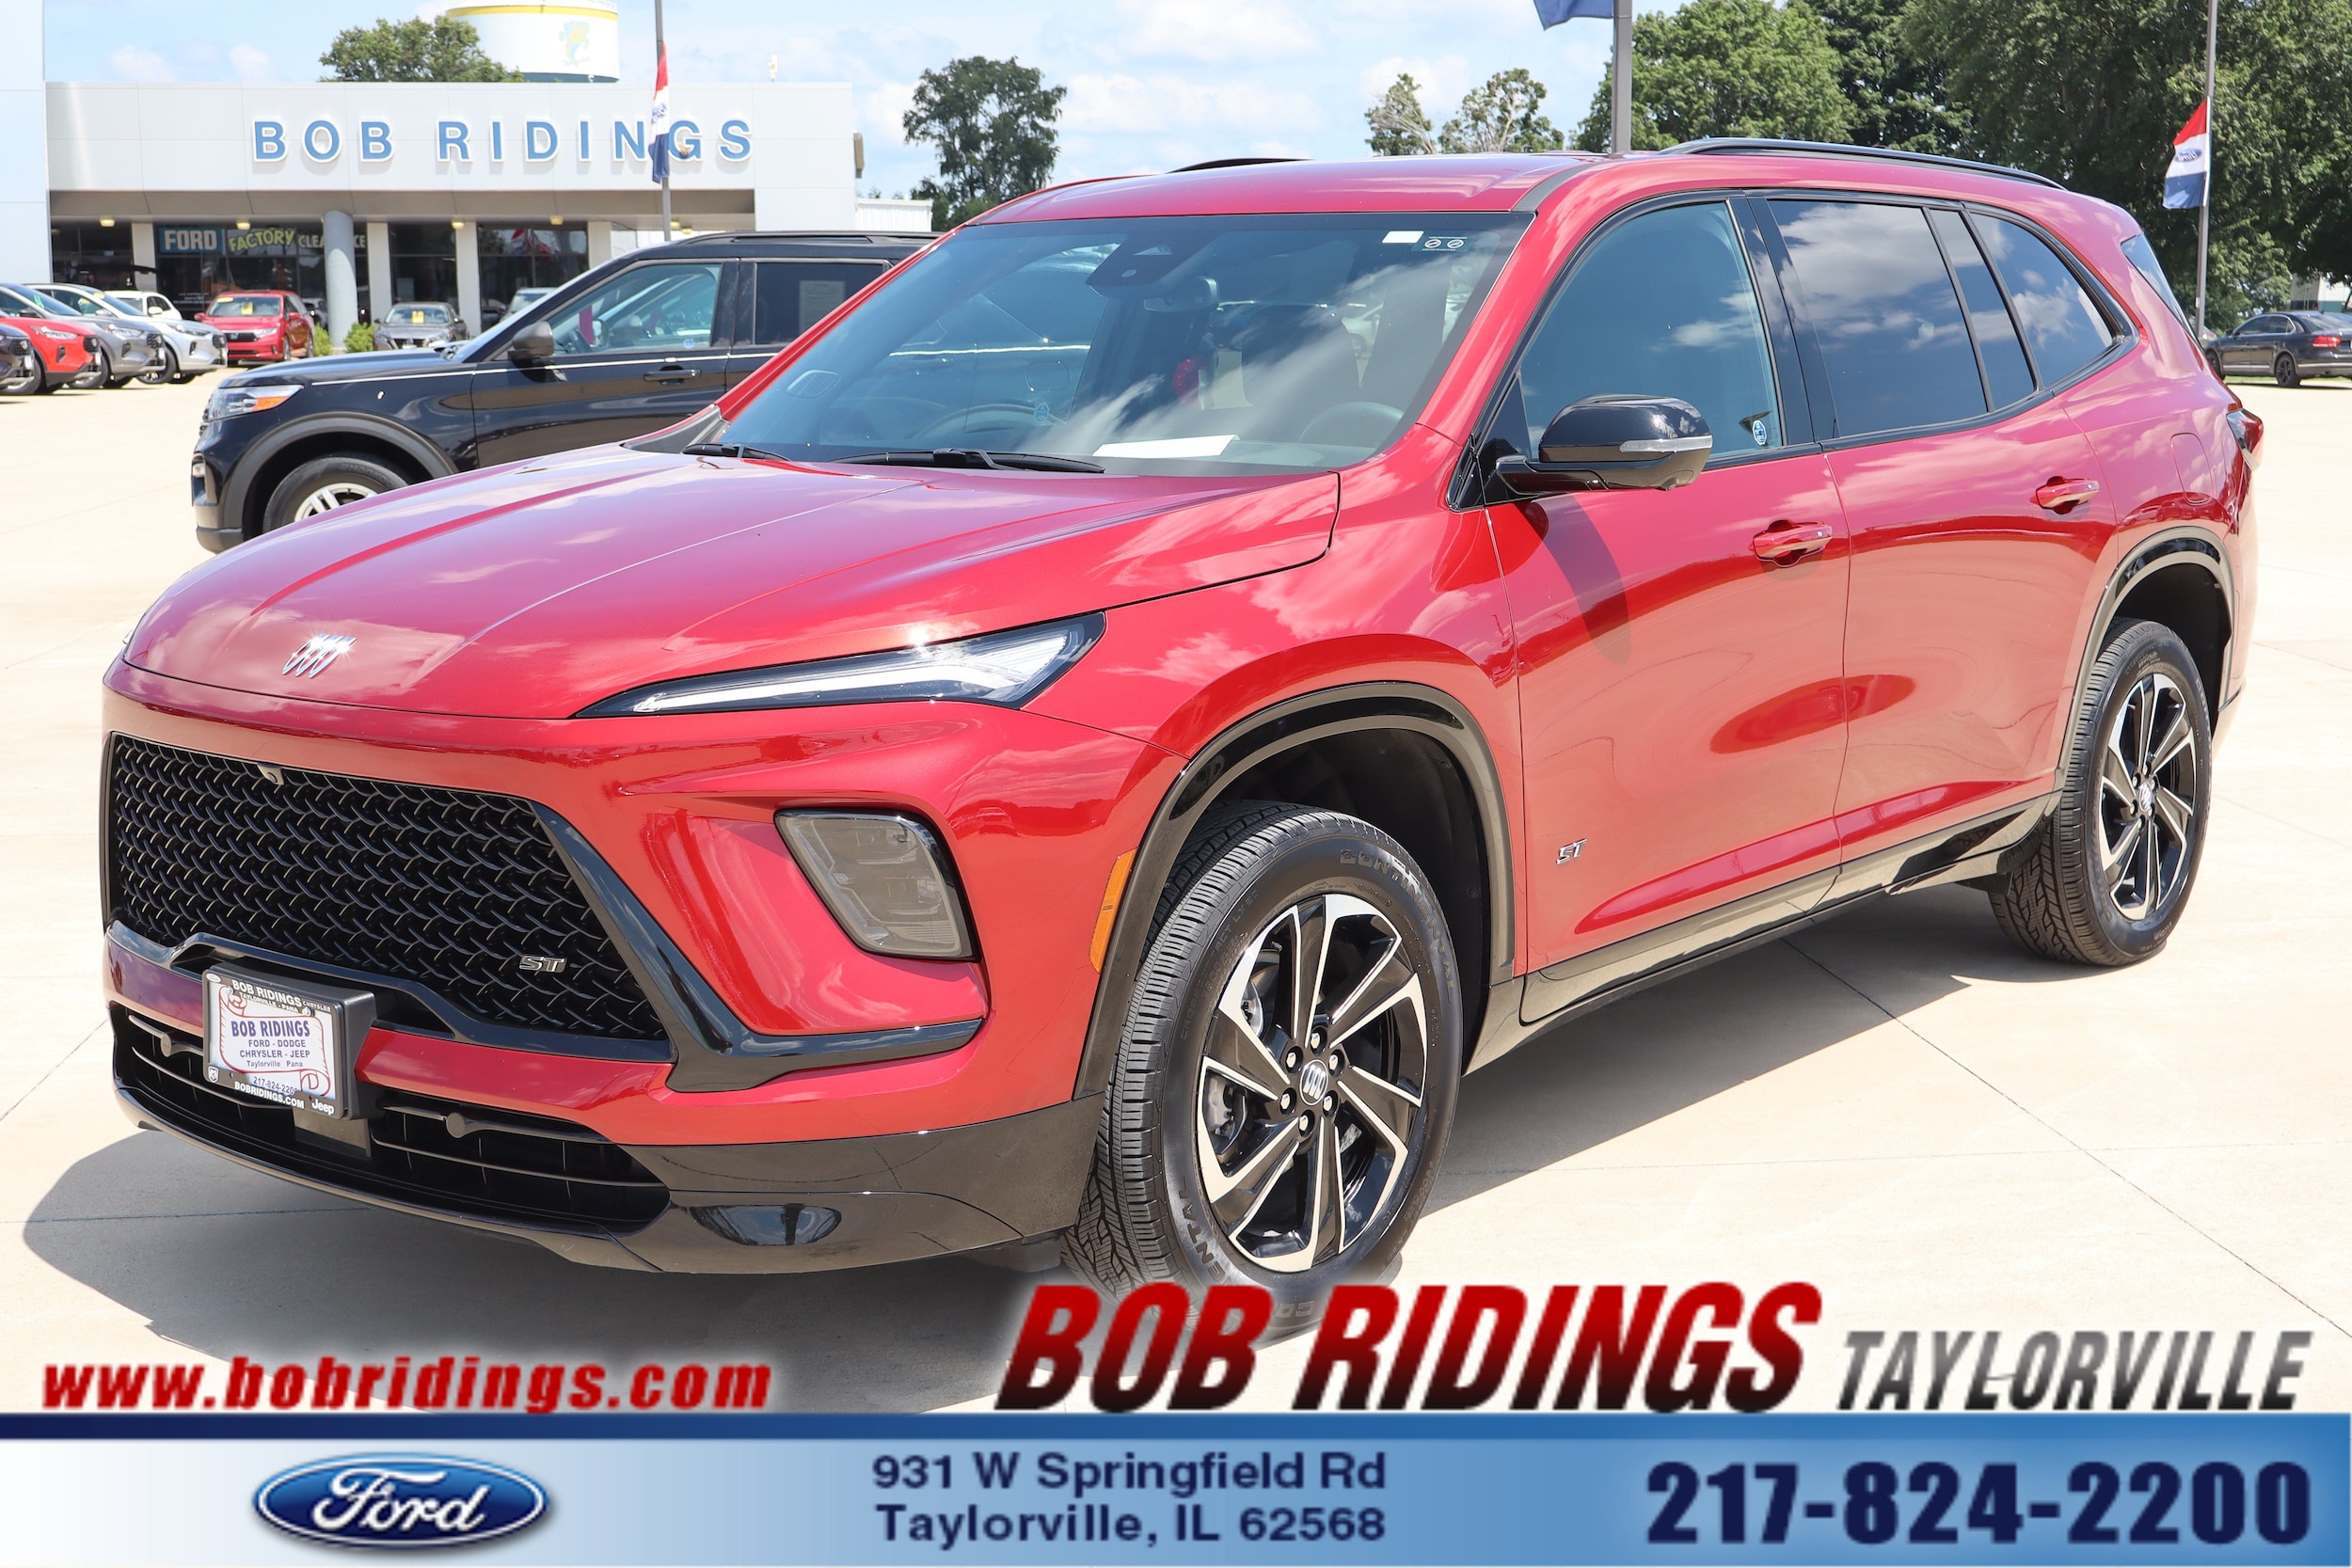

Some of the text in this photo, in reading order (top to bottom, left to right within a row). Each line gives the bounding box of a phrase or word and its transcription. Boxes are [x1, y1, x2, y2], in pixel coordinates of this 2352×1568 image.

[253, 119, 753, 162] BOB RIDINGS
[164, 230, 217, 250] FORD
[229, 230, 295, 252] FACTORY
[1556, 837, 1587, 864] ST
[518, 956, 566, 973] ST
[231, 979, 303, 1007] BOB RIDINGS
[239, 991, 278, 1007] TAYLORVILLE
[281, 1003, 300, 1013] PANA
[302, 1000, 332, 1012] CHRYSLER
[231, 1020, 310, 1037] BOB RIDINGS
[248, 1039, 271, 1048] FORD
[278, 1039, 307, 1048] DODGE
[239, 1050, 283, 1058] CHRYSLER
[290, 1050, 310, 1058] JEEP
[246, 1060, 281, 1069] Taylorville
[234, 1081, 305, 1109] BOBRIDINGS.COM
[311, 1098, 335, 1116] Jeep
